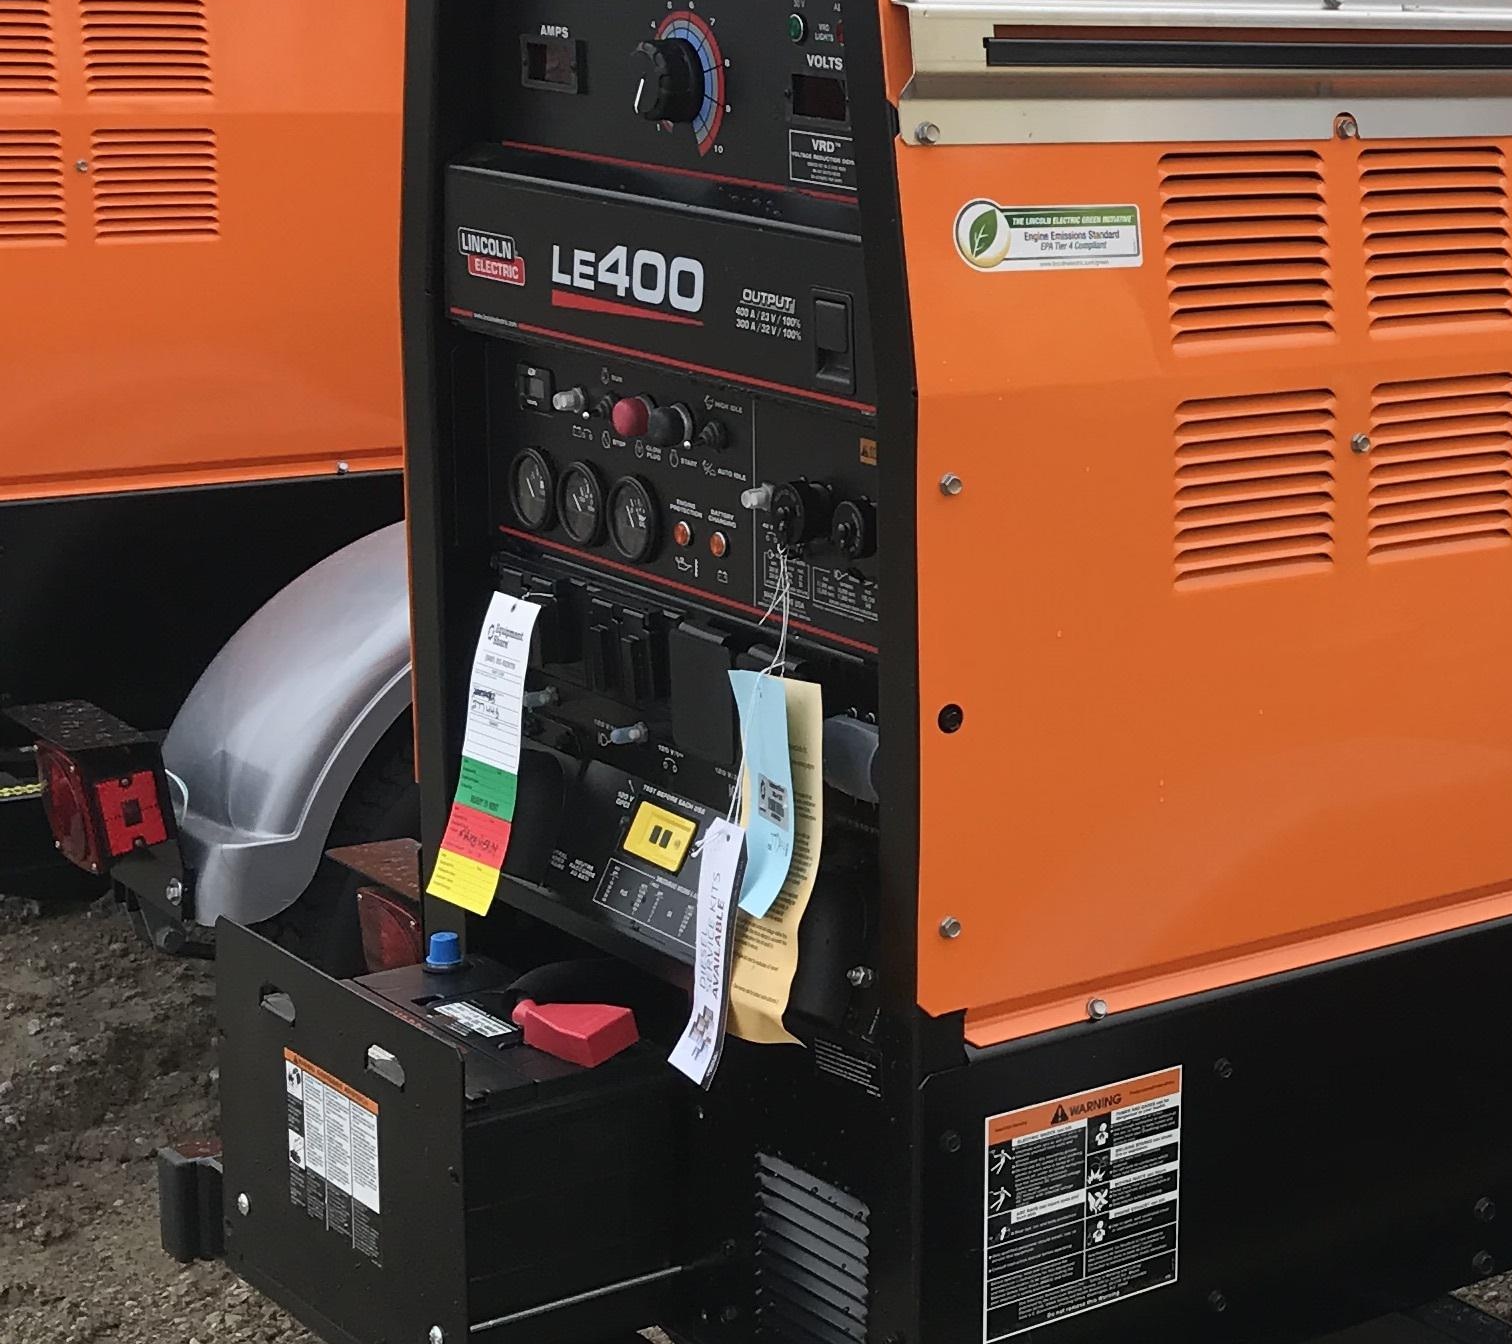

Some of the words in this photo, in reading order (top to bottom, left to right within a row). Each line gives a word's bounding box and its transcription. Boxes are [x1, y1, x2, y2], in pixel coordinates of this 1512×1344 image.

[540, 24, 569, 39] AMPS
[650, 20, 656, 29] 4
[709, 18, 716, 26] 7
[806, 53, 843, 71] VOLTS
[714, 145, 724, 154] 10
[1013, 217, 1024, 225] THE
[1026, 217, 1051, 225] LINCOLN
[1052, 216, 1080, 225] ELECTRIC
[462, 233, 512, 259] LINCOLN
[1024, 232, 1048, 242] Engine
[1051, 231, 1086, 240] Emissions
[1088, 230, 1120, 239] Standard
[1041, 242, 1053, 251] EPA
[1055, 242, 1067, 250] Tier
[1074, 241, 1107, 250] Compliant
[474, 258, 519, 279] ELECTRIC
[552, 244, 704, 313] LE400
[742, 288, 792, 309] OUTPUT
[735, 306, 749, 318] 400
[750, 309, 756, 319] A
[770, 313, 777, 323] V
[782, 316, 801, 329] 100%
[736, 318, 749, 330] 300
[750, 321, 756, 331] A
[761, 323, 770, 334] 32
[771, 325, 777, 335] V
[782, 328, 802, 341] 100%
[642, 784, 656, 795] TEST
[656, 790, 678, 804] BEFORE
[710, 871, 721, 909] KITS
[712, 900, 725, 1001] AVAILABLE
[1069, 1093, 1122, 1117] WARNING
